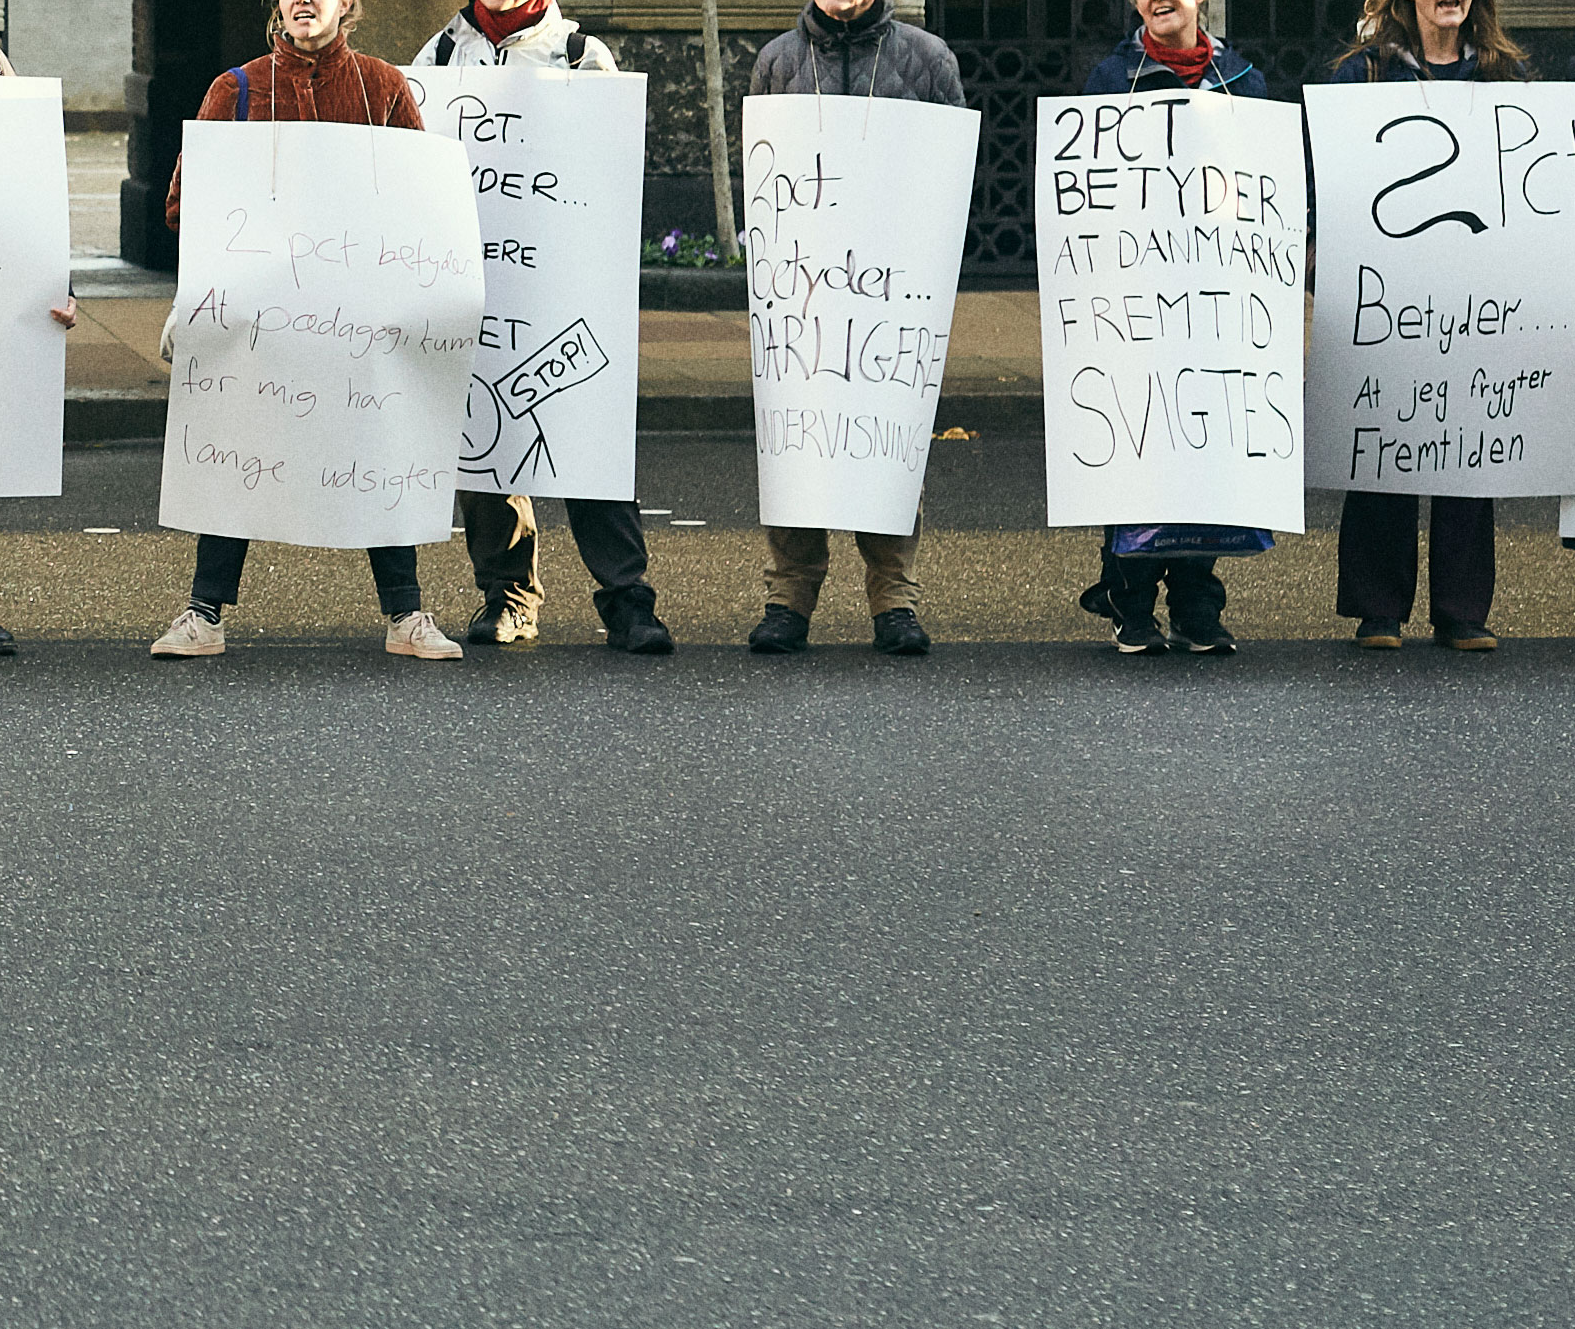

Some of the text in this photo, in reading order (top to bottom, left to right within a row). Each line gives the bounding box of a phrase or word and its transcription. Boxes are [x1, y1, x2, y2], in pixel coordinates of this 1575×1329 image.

[225, 207, 272, 255] 2
[287, 230, 360, 290] pct
[749, 226, 932, 320] Betyder...
[1054, 225, 1299, 288] AT DANMARKS
[187, 286, 230, 331] At
[1058, 290, 1273, 349] FREMTID
[181, 355, 401, 418] for mig har
[510, 331, 592, 404] STOP!
[1352, 367, 1552, 423] At jeg frygter
[1070, 365, 1295, 468] SVIGTES
[182, 423, 452, 511] lange udsigter
[1350, 426, 1525, 480] Fremtiden
